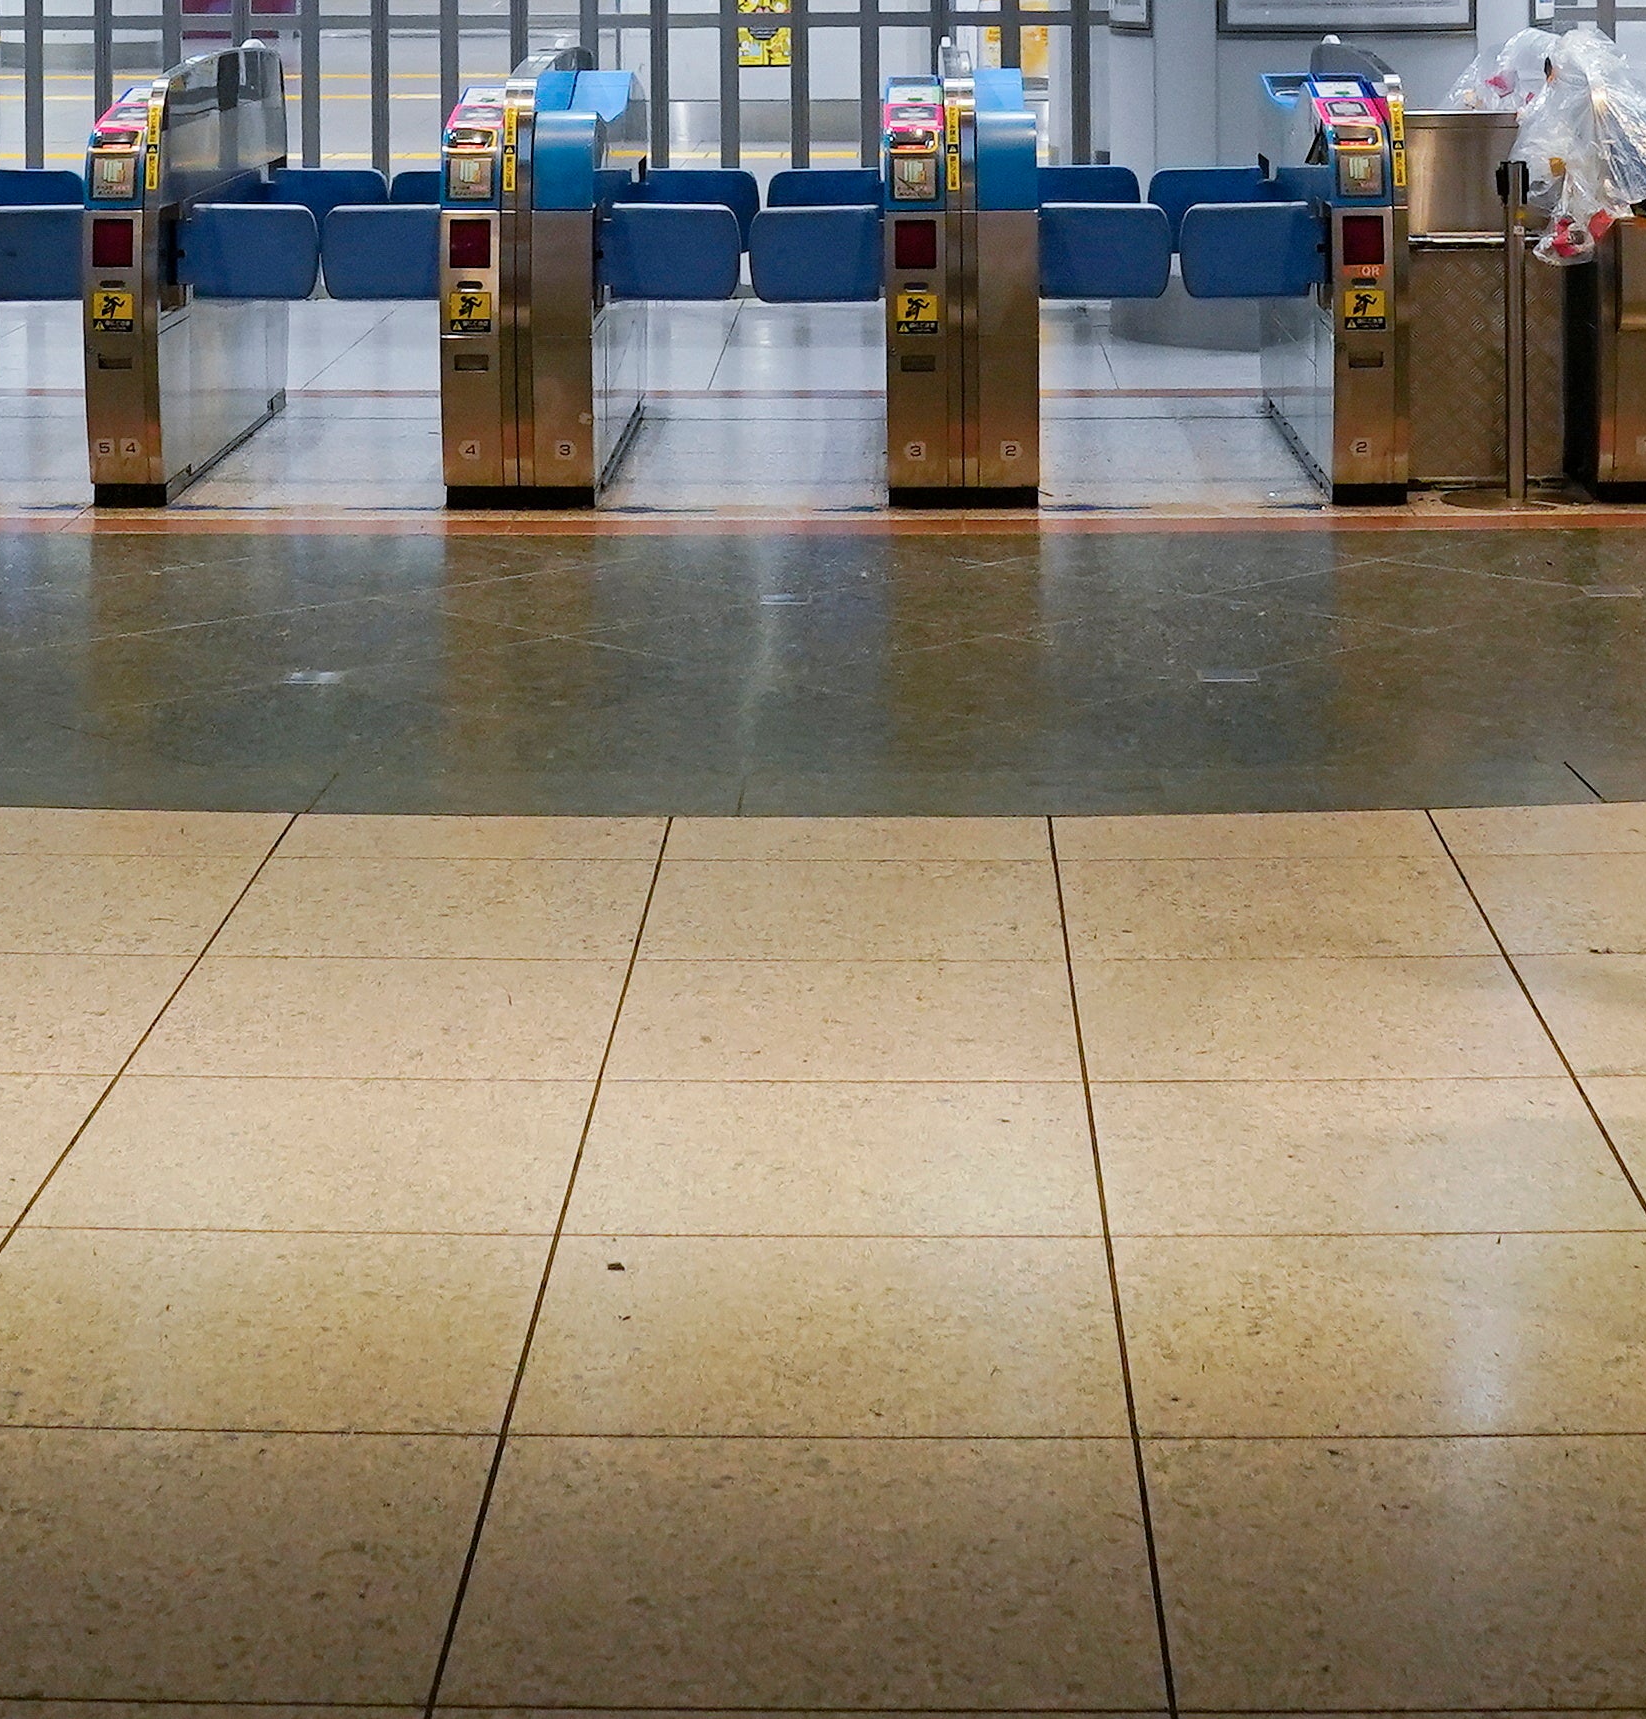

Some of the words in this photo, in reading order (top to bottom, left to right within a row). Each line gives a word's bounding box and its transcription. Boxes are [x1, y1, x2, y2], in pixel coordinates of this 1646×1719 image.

[99, 442, 110, 454] 5
[125, 442, 136, 453] 4
[464, 443, 477, 457] 4
[558, 443, 572, 457] 3
[909, 444, 923, 458] 3
[1004, 443, 1017, 458] 2
[1355, 441, 1367, 453] 2
